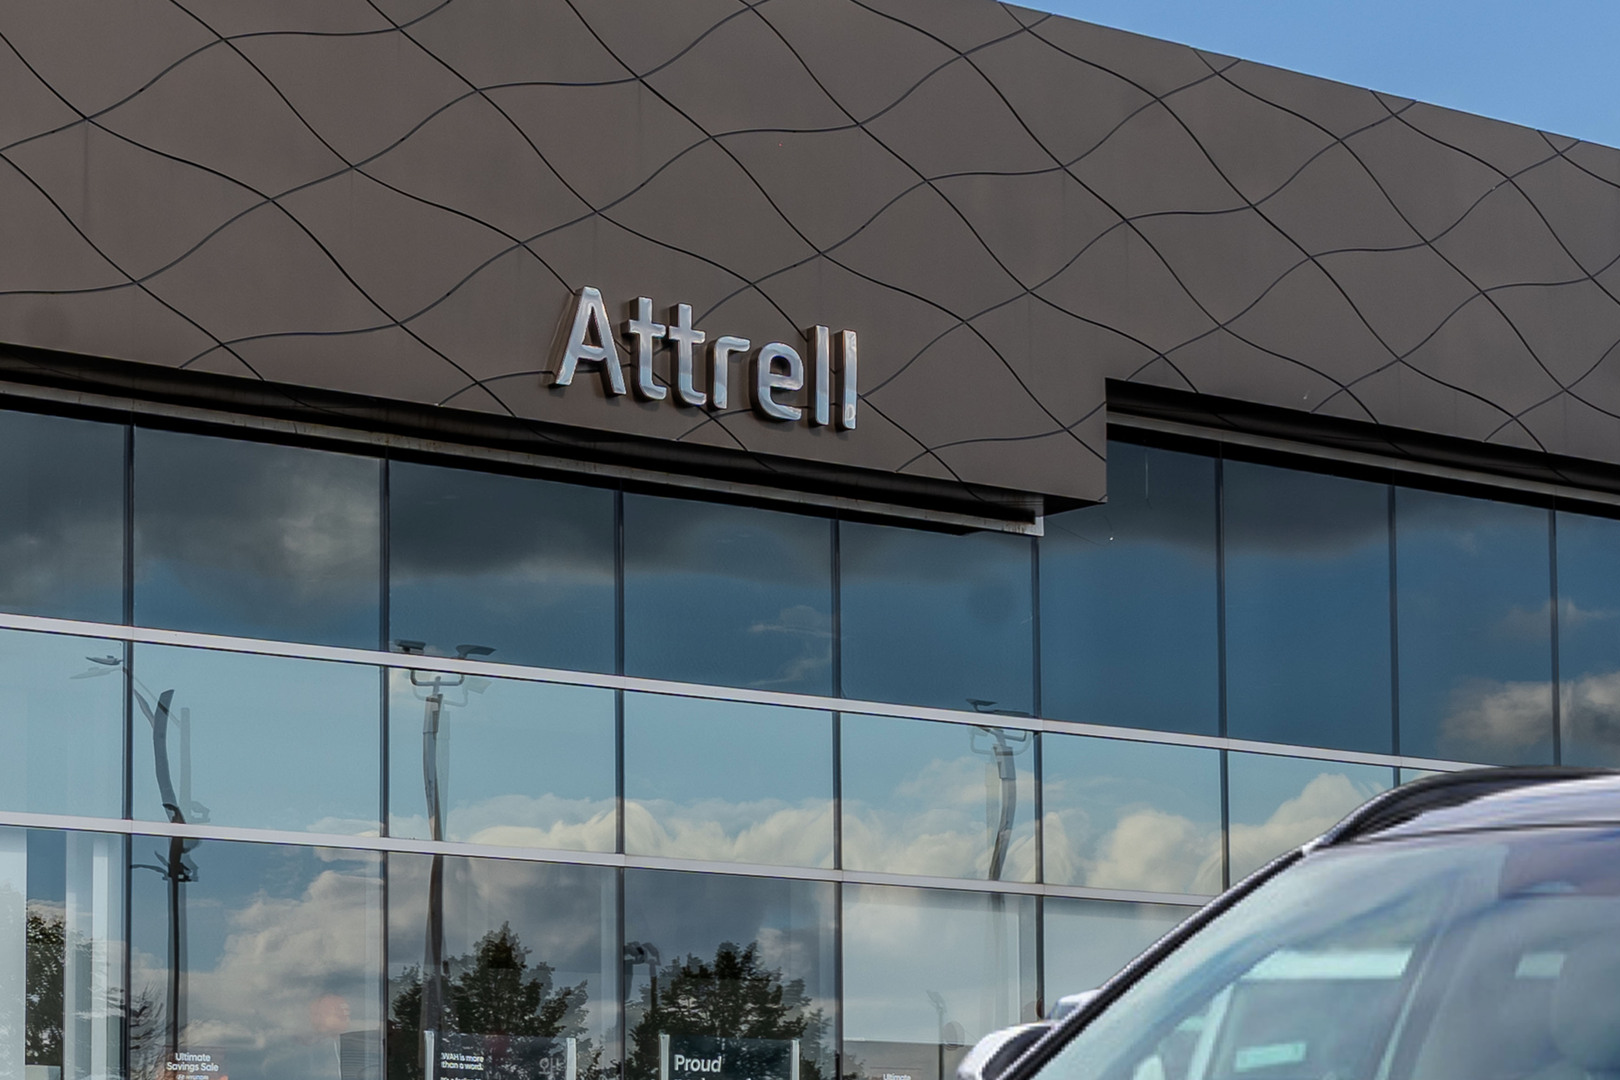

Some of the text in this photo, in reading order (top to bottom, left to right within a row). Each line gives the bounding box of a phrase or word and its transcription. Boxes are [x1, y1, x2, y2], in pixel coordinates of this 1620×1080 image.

[549, 285, 858, 430] Attrell
[175, 1052, 211, 1061] Ultimate
[166, 1062, 219, 1072] Savings Sale
[674, 1054, 722, 1072] Proud
[883, 1073, 911, 1080] Ultimate
